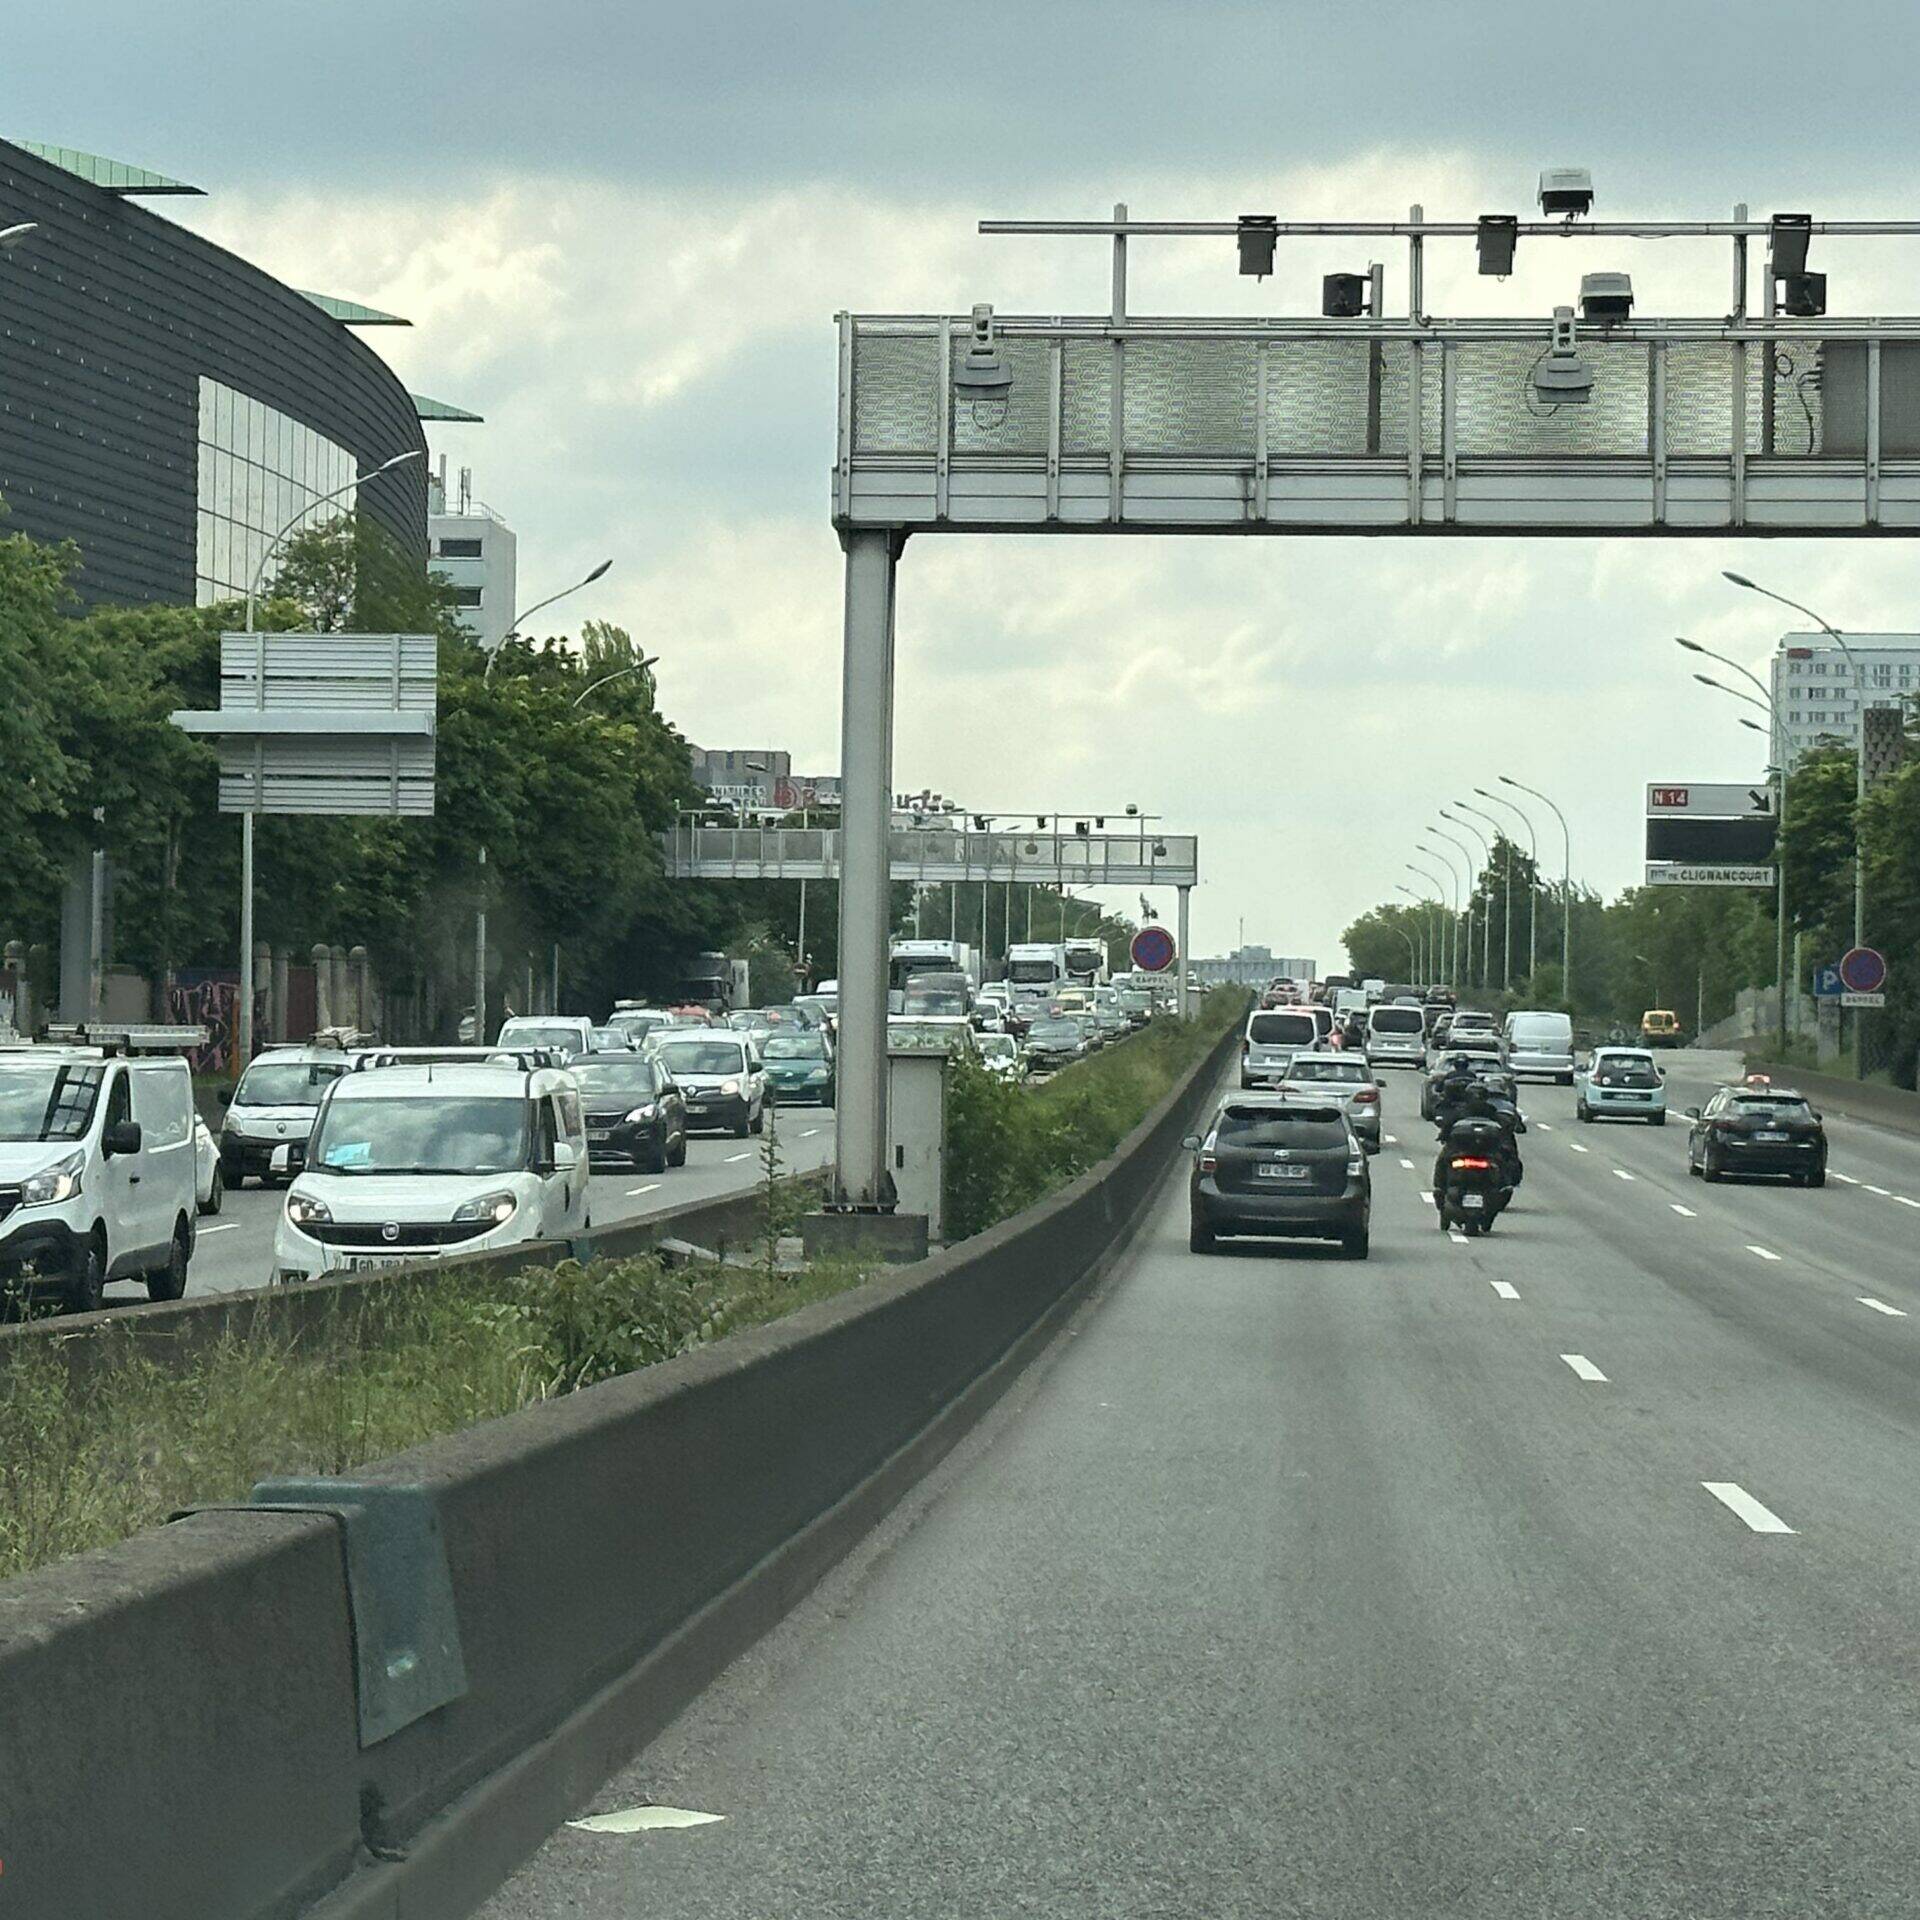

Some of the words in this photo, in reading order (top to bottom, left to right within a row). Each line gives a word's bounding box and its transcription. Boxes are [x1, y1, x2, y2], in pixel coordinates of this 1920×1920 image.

[1654, 791, 1663, 804] N
[1668, 791, 1686, 804] 14
[1680, 869, 1770, 882] CLIGNANCOURT
[1823, 970, 1838, 990] P
